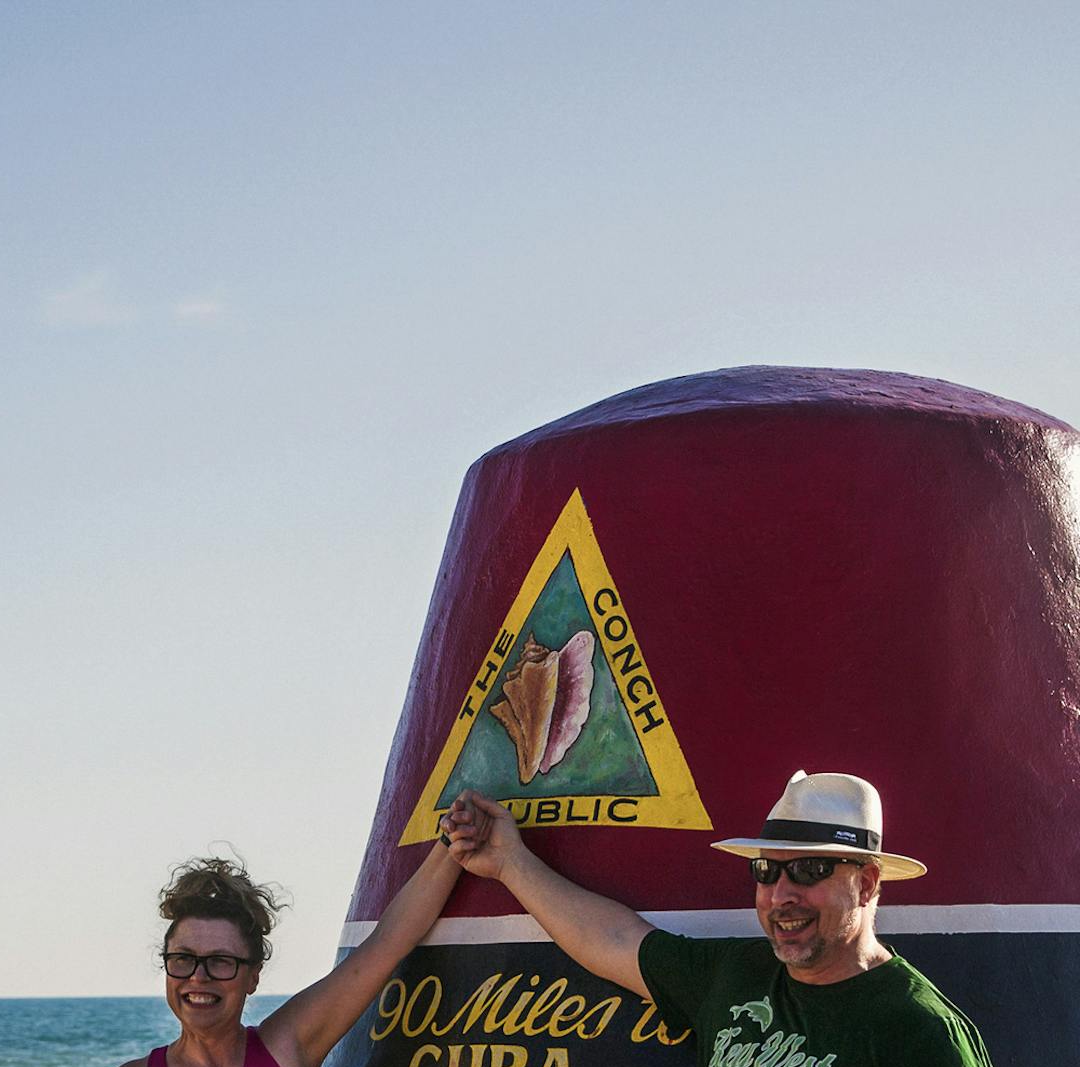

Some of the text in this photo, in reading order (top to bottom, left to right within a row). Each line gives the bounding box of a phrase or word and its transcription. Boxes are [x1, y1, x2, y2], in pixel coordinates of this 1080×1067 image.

[459, 629, 515, 720] THE
[593, 588, 664, 733] CONCH
[370, 975, 443, 1041] 90
[431, 973, 622, 1039] Miles
